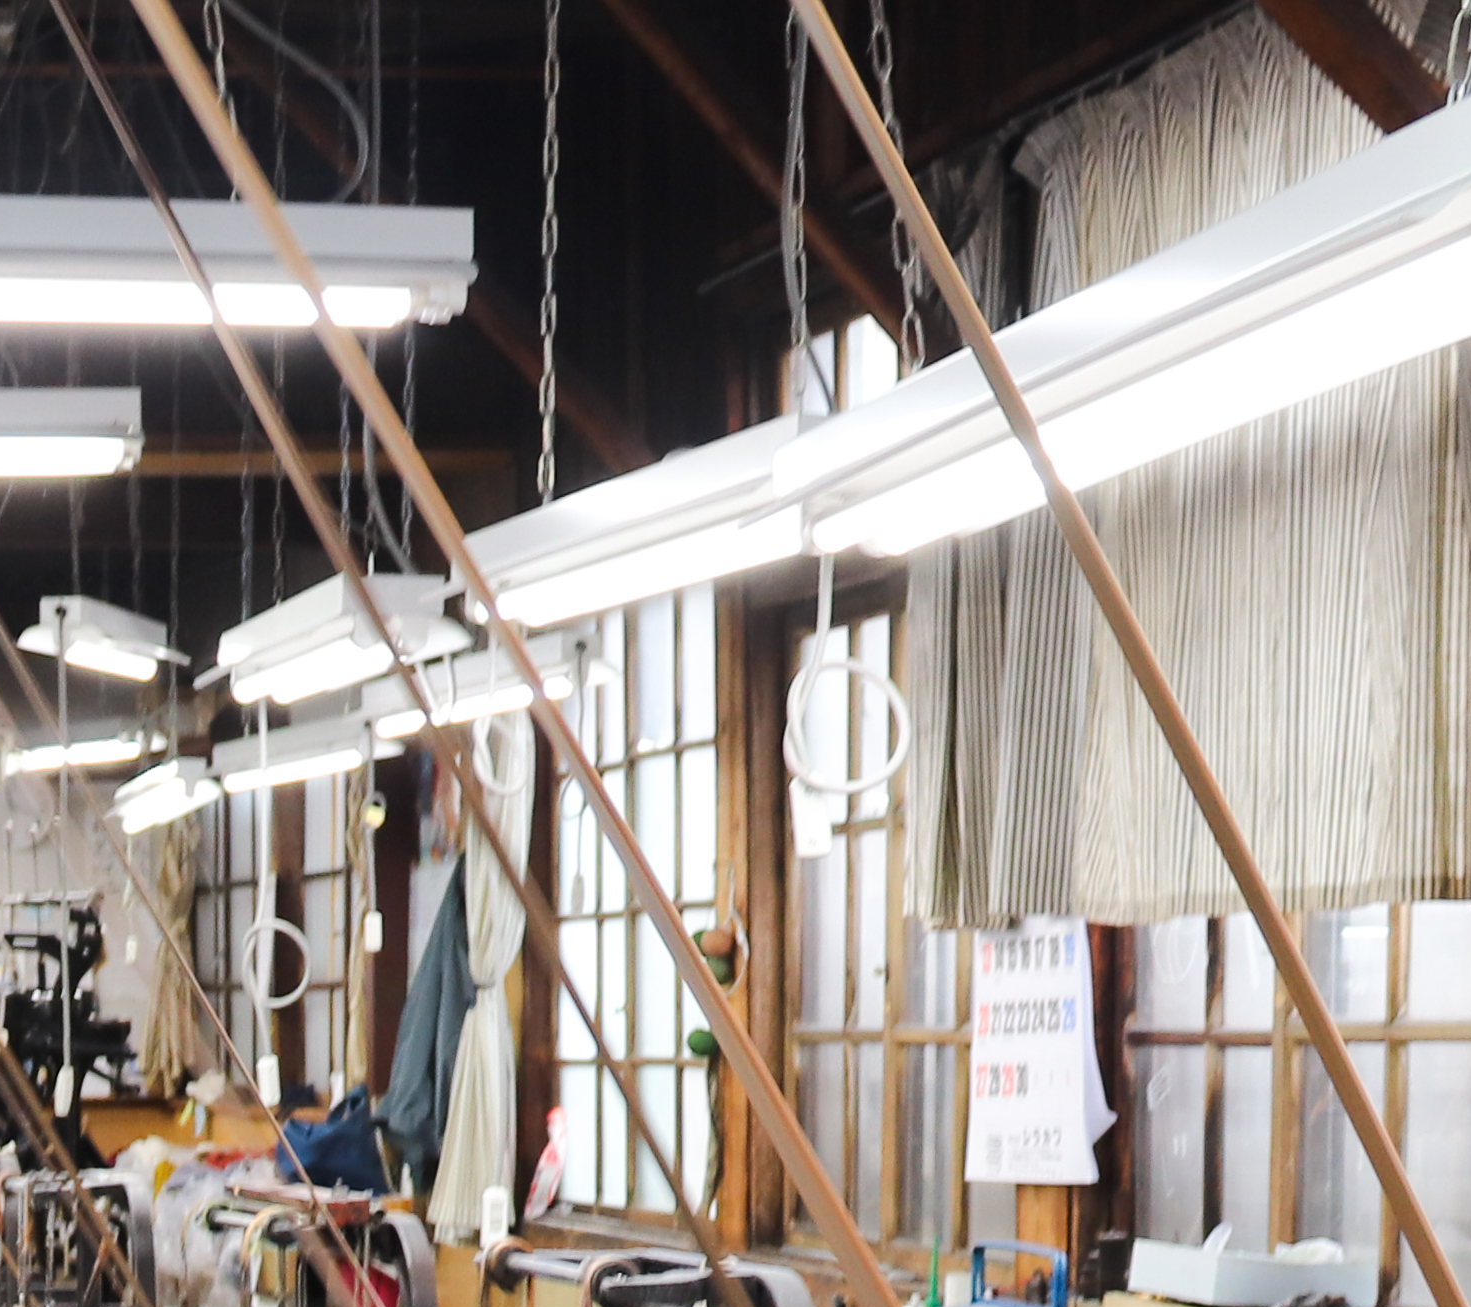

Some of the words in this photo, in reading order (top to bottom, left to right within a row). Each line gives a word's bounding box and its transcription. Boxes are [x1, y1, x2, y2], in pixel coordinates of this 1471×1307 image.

[991, 1003, 1002, 1035] 21
[1003, 1001, 1016, 1036] 22
[1017, 1001, 1030, 1035] 23
[1031, 1000, 1045, 1035] 24
[1046, 1000, 1061, 1034] 25
